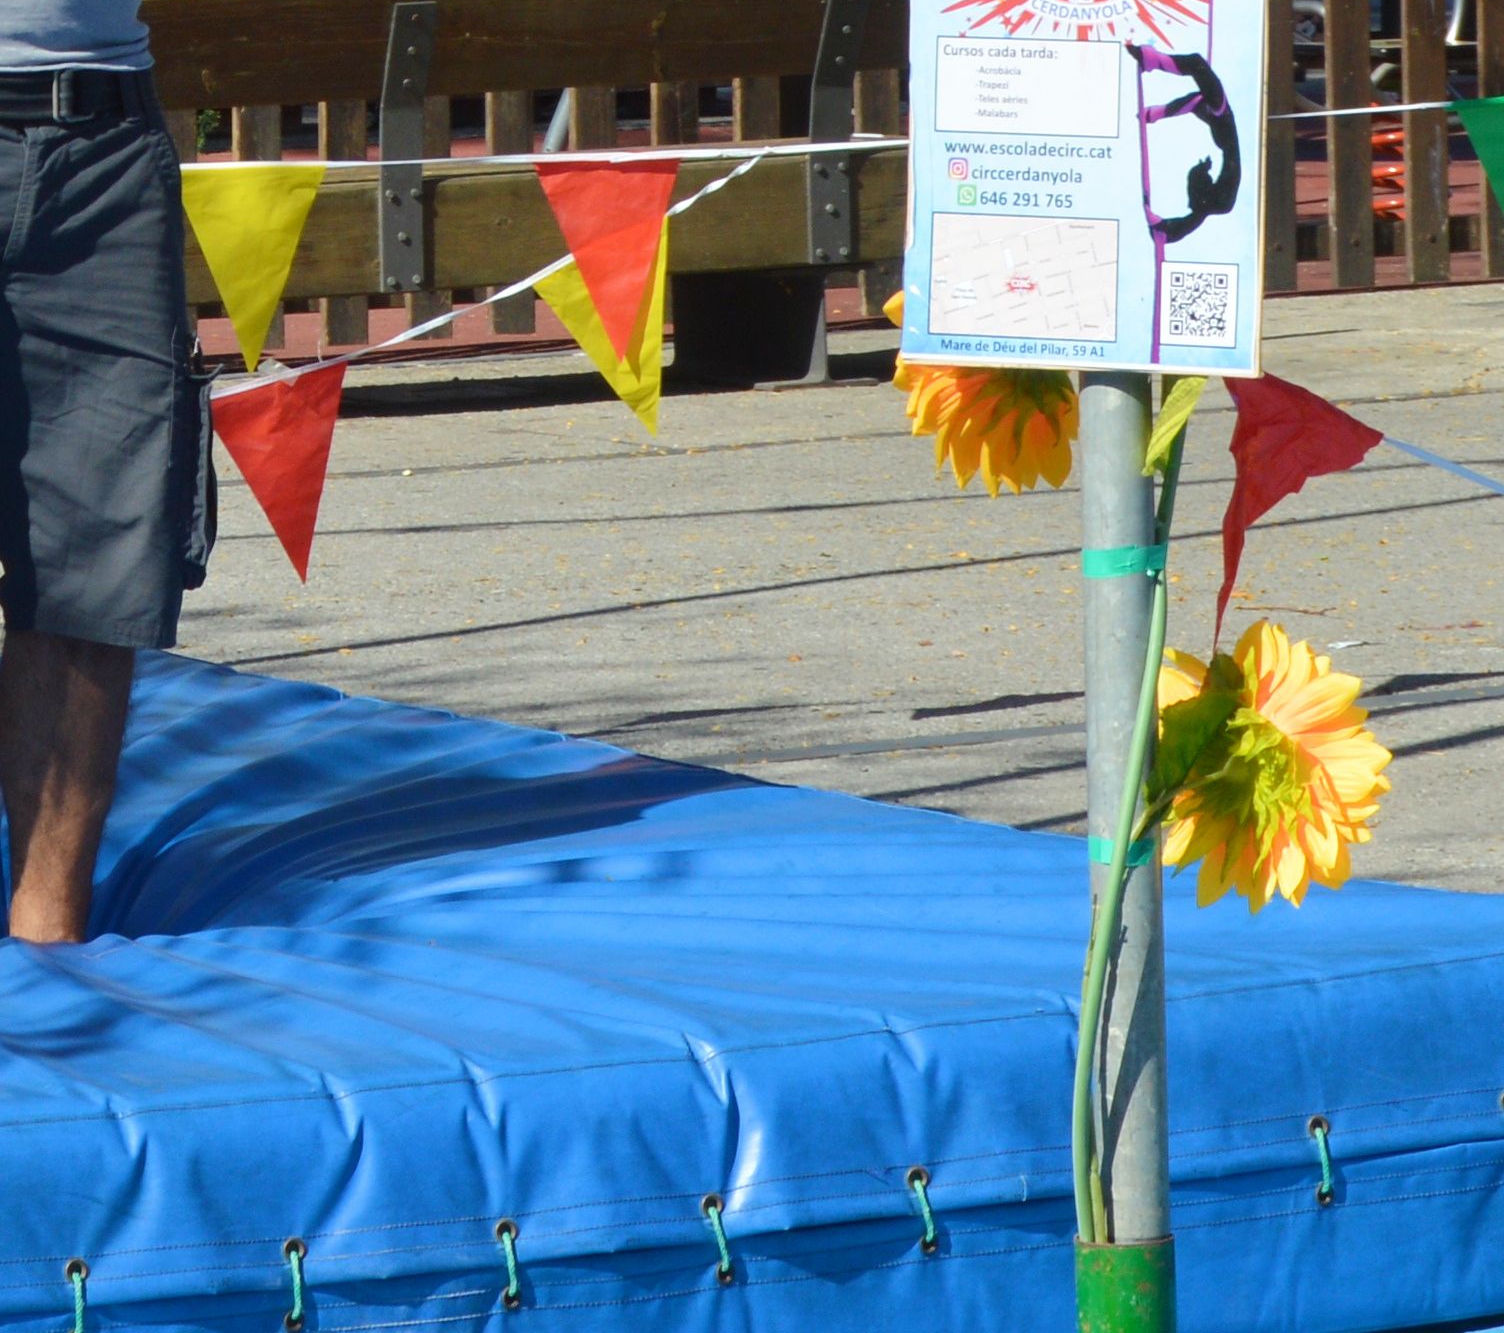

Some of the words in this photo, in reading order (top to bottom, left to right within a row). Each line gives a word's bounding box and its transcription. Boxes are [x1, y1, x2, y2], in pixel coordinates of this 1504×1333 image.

[943, 44, 984, 58] Cursos
[988, 46, 1017, 58] cada
[1021, 47, 1059, 59] tarda:
[945, 141, 1112, 159] www.escoladecirc.cat
[971, 165, 1083, 186] circcerdanyola
[980, 191, 1008, 206] 646
[1012, 192, 1040, 207] 291
[1046, 194, 1073, 209] 765
[941, 339, 972, 351] Mare
[975, 340, 990, 352] de
[993, 341, 1016, 353] Déu
[1019, 342, 1037, 354] del
[1041, 344, 1069, 357] Pilar,
[1072, 345, 1086, 356] 59
[1090, 346, 1105, 357] A1
